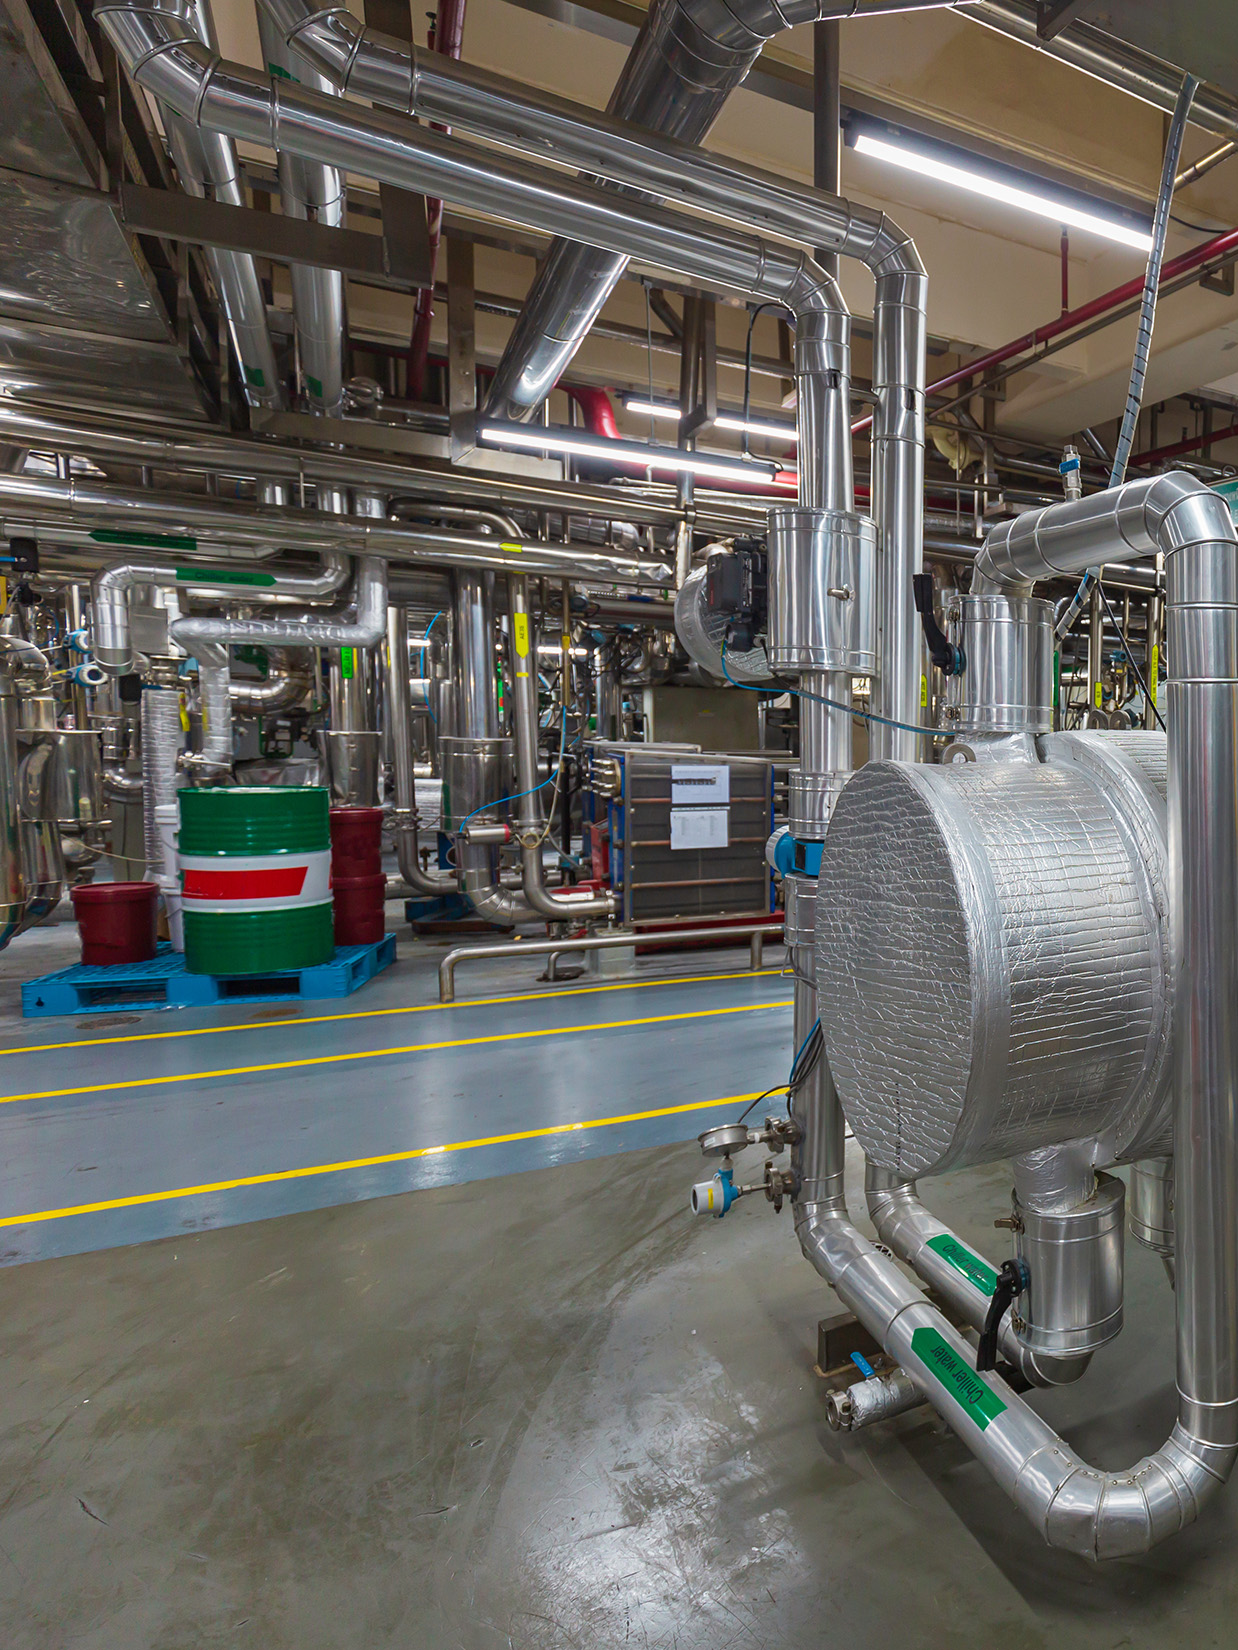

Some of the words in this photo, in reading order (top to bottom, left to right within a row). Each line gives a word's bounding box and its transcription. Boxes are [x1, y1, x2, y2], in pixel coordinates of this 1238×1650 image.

[942, 1244, 969, 1264] Chiller
[930, 1345, 958, 1373] water
[952, 1369, 984, 1404] Chiller
